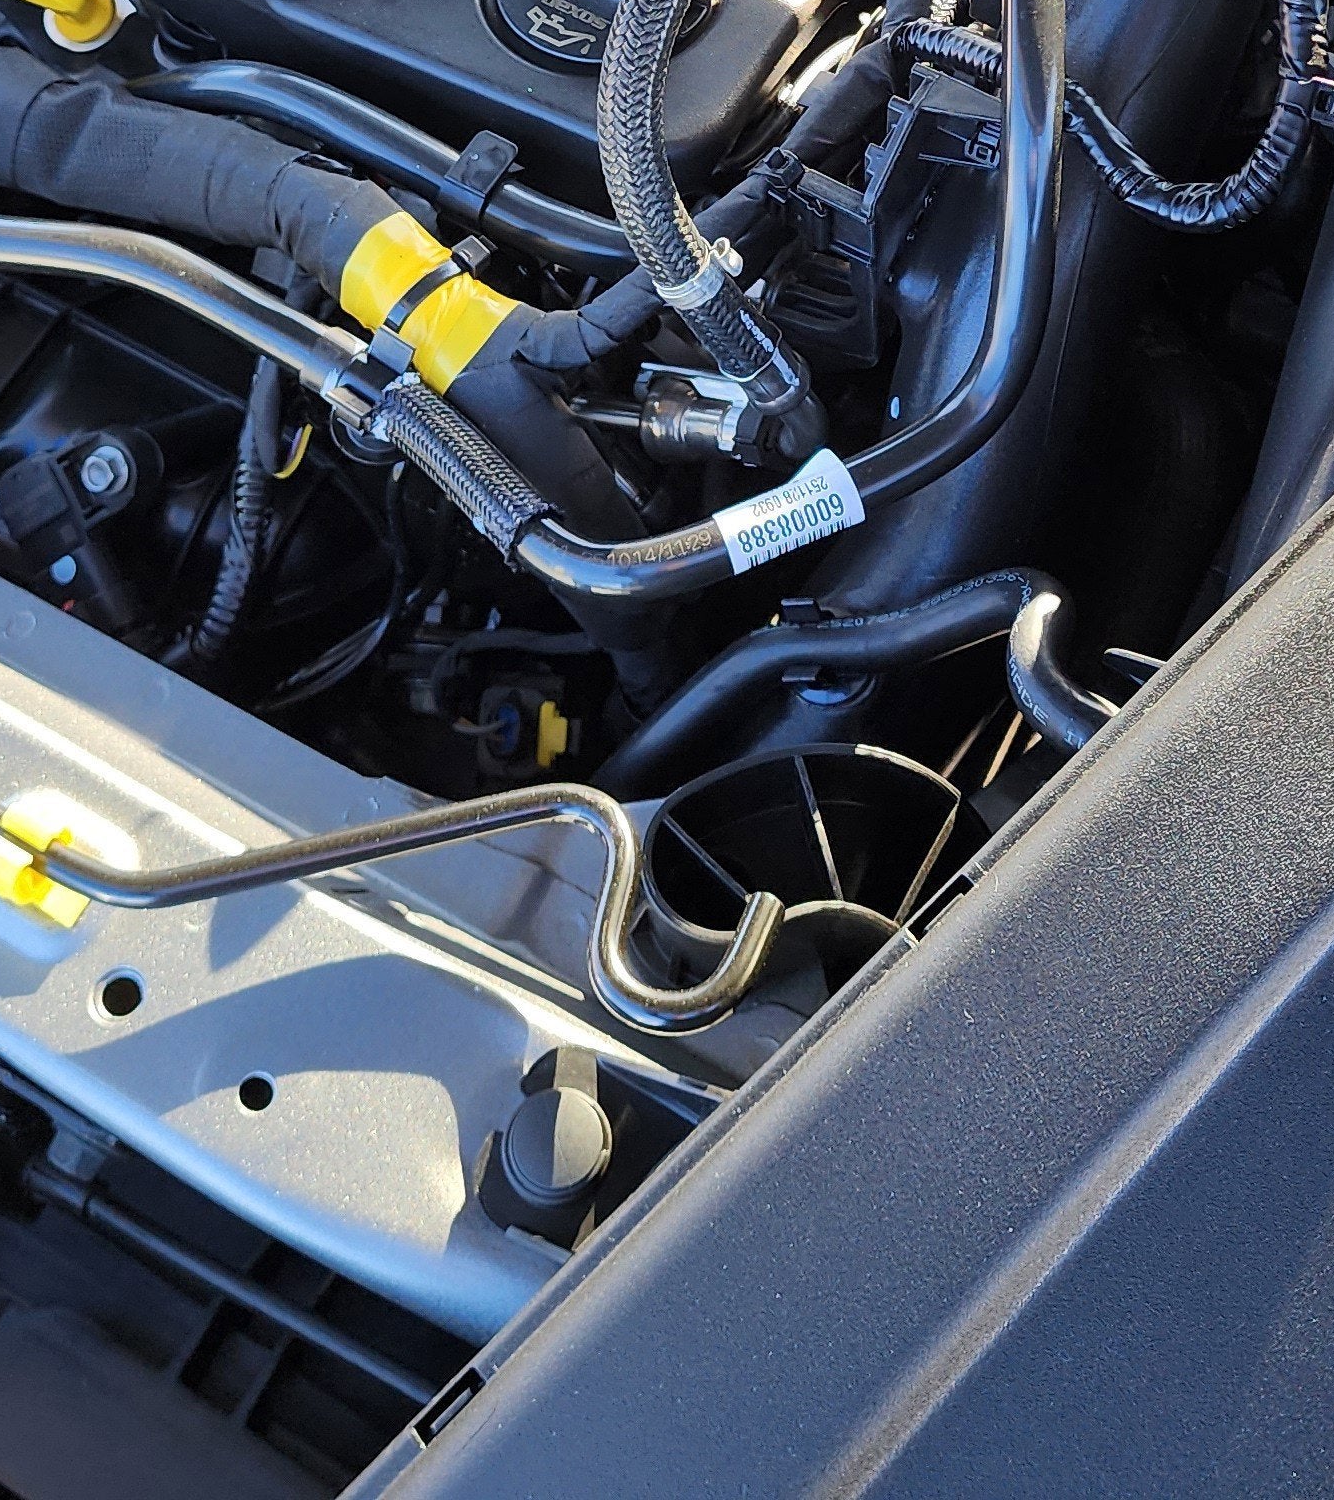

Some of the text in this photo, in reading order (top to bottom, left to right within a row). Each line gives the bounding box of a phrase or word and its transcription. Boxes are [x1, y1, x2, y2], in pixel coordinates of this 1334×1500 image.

[736, 491, 847, 555] 60008388
[749, 493, 782, 518] 0932
[1007, 654, 1050, 728] MADE
